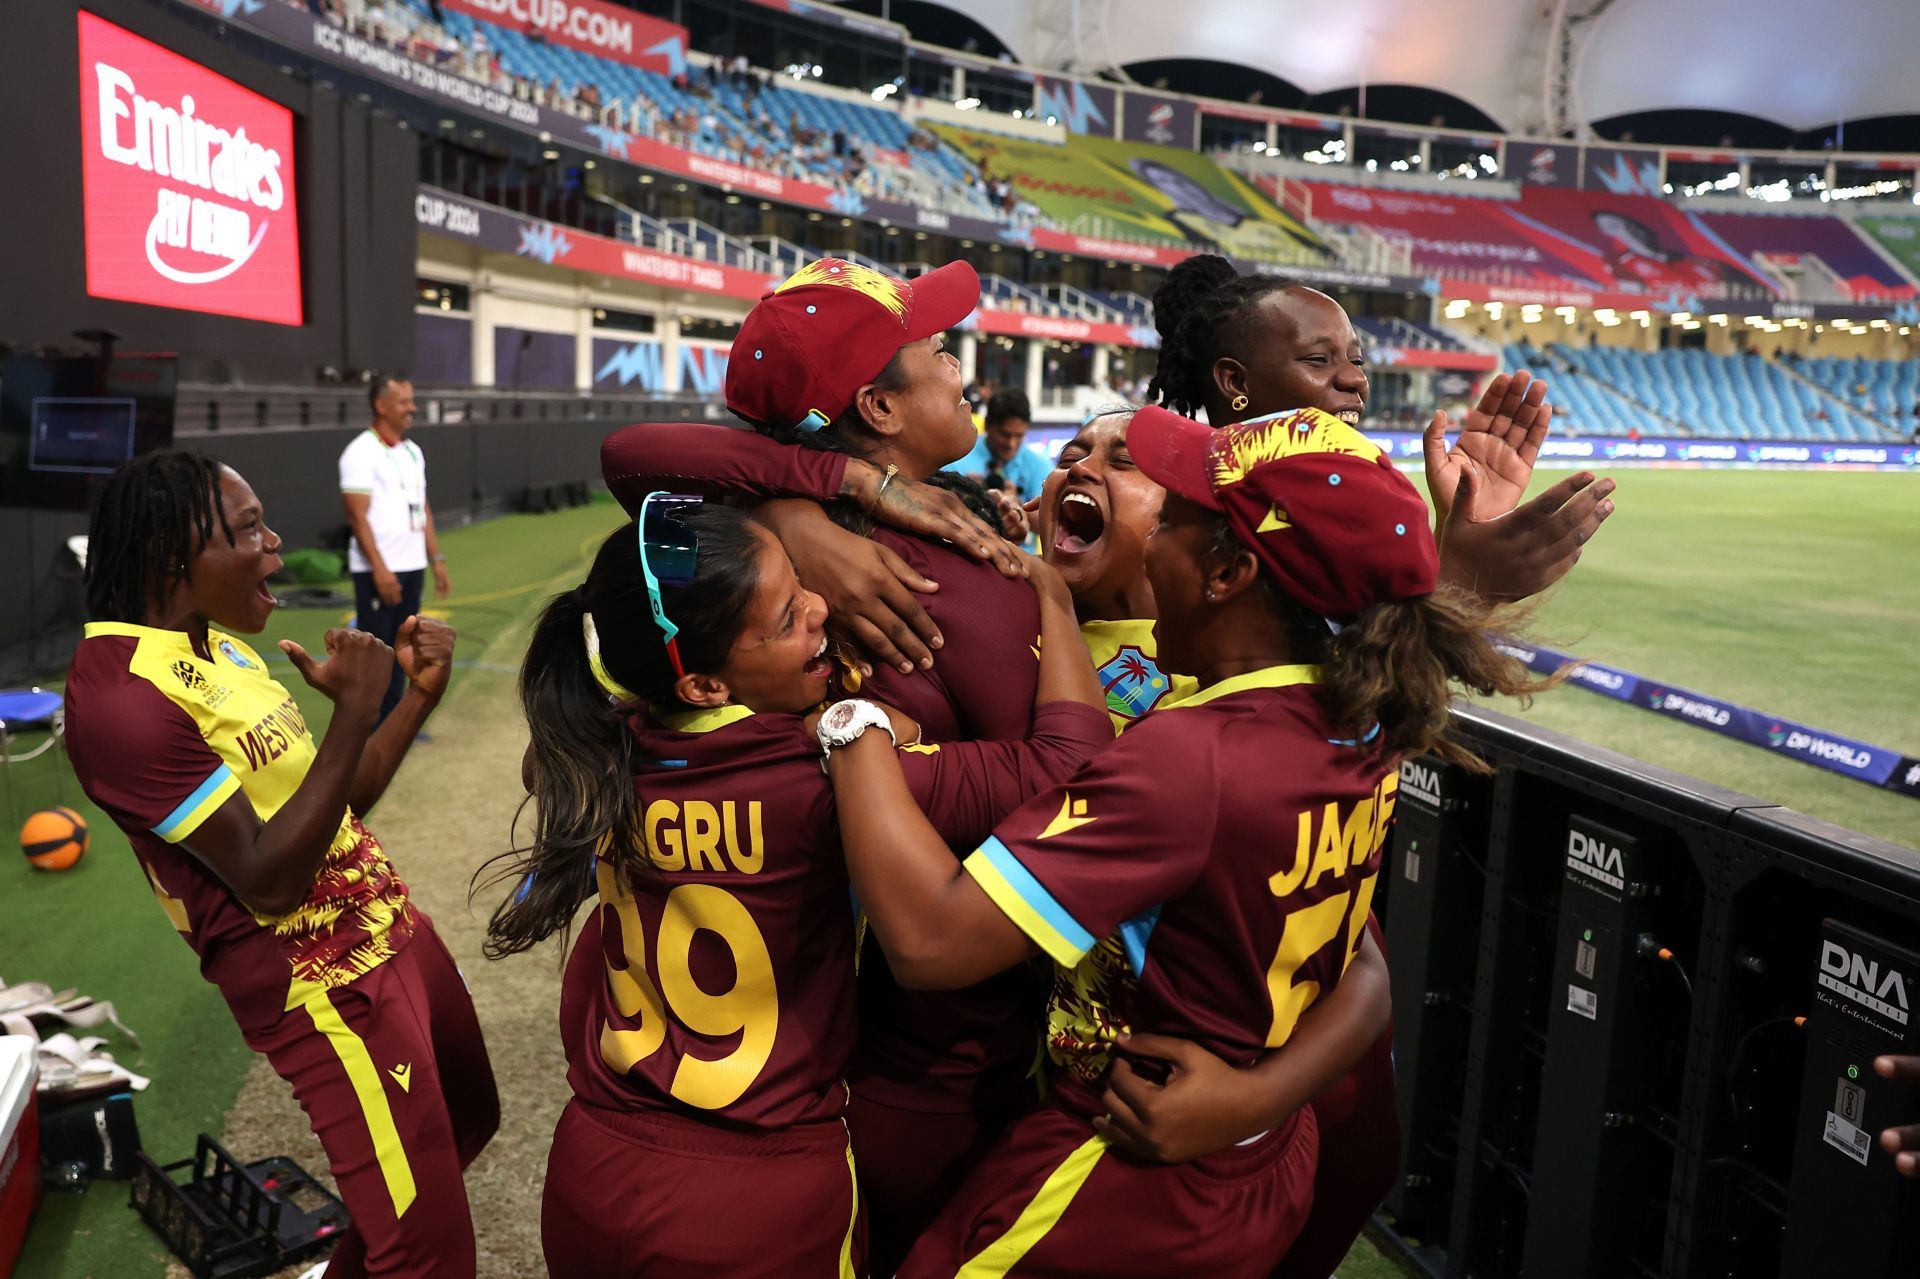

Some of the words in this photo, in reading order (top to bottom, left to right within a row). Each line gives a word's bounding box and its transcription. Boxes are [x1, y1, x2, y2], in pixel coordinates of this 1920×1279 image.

[95, 62, 283, 211] Emirates
[416, 194, 446, 228] CUP
[446, 202, 480, 237] 2024
[1682, 700, 1731, 726] WORLD
[235, 714, 295, 773] WEST
[1786, 731, 1810, 750] DP
[1809, 738, 1871, 769] WORLD
[1400, 759, 1441, 796] DNA
[1568, 829, 1625, 879] DNA
[1820, 939, 1909, 1011] DNA
[1817, 991, 1839, 1009] That's
[1841, 1004, 1904, 1040] Entertainment
